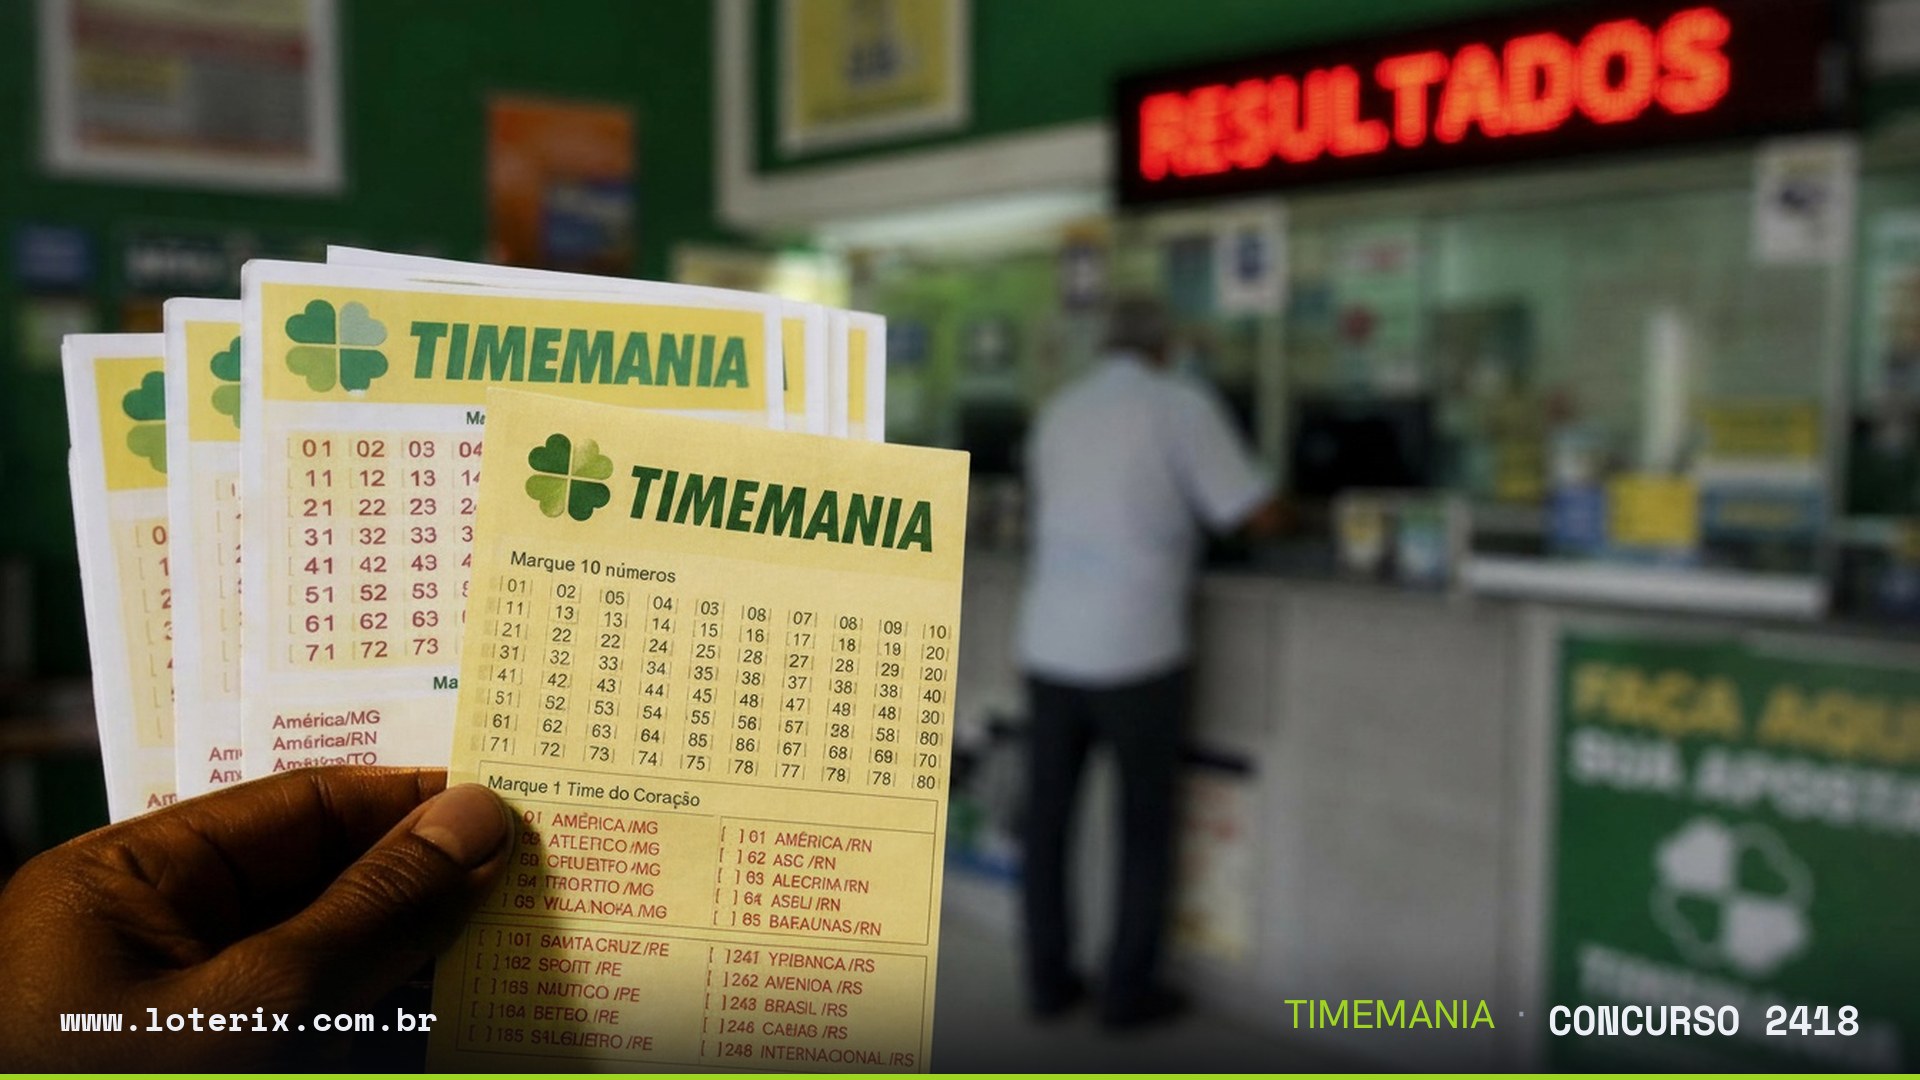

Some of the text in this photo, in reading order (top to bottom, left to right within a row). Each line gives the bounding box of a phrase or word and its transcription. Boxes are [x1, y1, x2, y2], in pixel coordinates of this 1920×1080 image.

[1139, 7, 1731, 180] RESULTADOS
[410, 321, 749, 388] TIMEMANIA
[302, 439, 483, 458] 01 02 03 04
[305, 469, 332, 488] 11
[359, 469, 386, 487] 12
[410, 469, 436, 487] 13
[303, 498, 437, 517] 21 22 23
[630, 465, 933, 552] TIMEMANIA
[304, 526, 437, 546] 31 32 33
[303, 554, 438, 575] 41 42 43
[581, 559, 601, 575] 10
[605, 563, 677, 583] números
[305, 582, 439, 604] 51 52 53
[507, 578, 526, 593] 01
[556, 584, 577, 599] 02
[653, 596, 673, 611] 04
[700, 601, 720, 616] 03
[747, 606, 767, 622] 08
[793, 611, 813, 625] 07
[839, 616, 858, 630] 08
[929, 625, 947, 639] 10
[305, 610, 439, 633] 61 62 63
[506, 601, 523, 616] 11
[556, 605, 575, 620] 13
[604, 611, 623, 628] 13
[653, 618, 671, 632] 14
[700, 623, 719, 638] 15
[746, 628, 765, 643] 16
[793, 633, 811, 647] 17
[925, 646, 945, 661] 20
[305, 638, 439, 662] 71 72 73
[501, 623, 522, 638] 21
[551, 627, 572, 643] 22
[600, 633, 621, 649] 22
[648, 639, 668, 654] 24
[695, 643, 716, 659] 25
[788, 653, 809, 669] 27
[834, 658, 854, 673] 28
[880, 662, 900, 677] 29
[924, 667, 944, 682] 20
[499, 645, 520, 660] 31
[549, 650, 571, 665] 32
[598, 656, 619, 671] 33
[646, 661, 666, 675] 34
[693, 666, 714, 681] 35
[740, 671, 761, 686] 38
[787, 676, 807, 690] 37
[833, 679, 853, 694] 38
[923, 689, 942, 703] 40
[497, 668, 897, 721] 41 42 43 44 45 48 47 48
[272, 710, 381, 730] América/MG
[593, 701, 615, 716] 53
[642, 706, 663, 720] 54
[690, 710, 711, 725] 55
[737, 715, 757, 730] 56
[784, 720, 804, 734] 57
[875, 727, 895, 742] 58
[919, 731, 939, 746] 80
[492, 714, 511, 729] 61
[542, 718, 563, 734] 62
[591, 724, 612, 739] 63
[640, 729, 661, 743] 64
[734, 737, 756, 753] 86
[782, 742, 802, 756] 67
[828, 745, 848, 760] 68
[918, 753, 938, 768] 70
[489, 736, 936, 790] 71 72 73 74 75 78 77 78 78 80
[487, 775, 548, 796] Marque
[553, 781, 560, 795] 1
[567, 781, 605, 798] Time
[609, 785, 630, 801] do
[747, 850, 836, 870] 62 ASC /RN
[764, 998, 817, 1015] BRASIL
